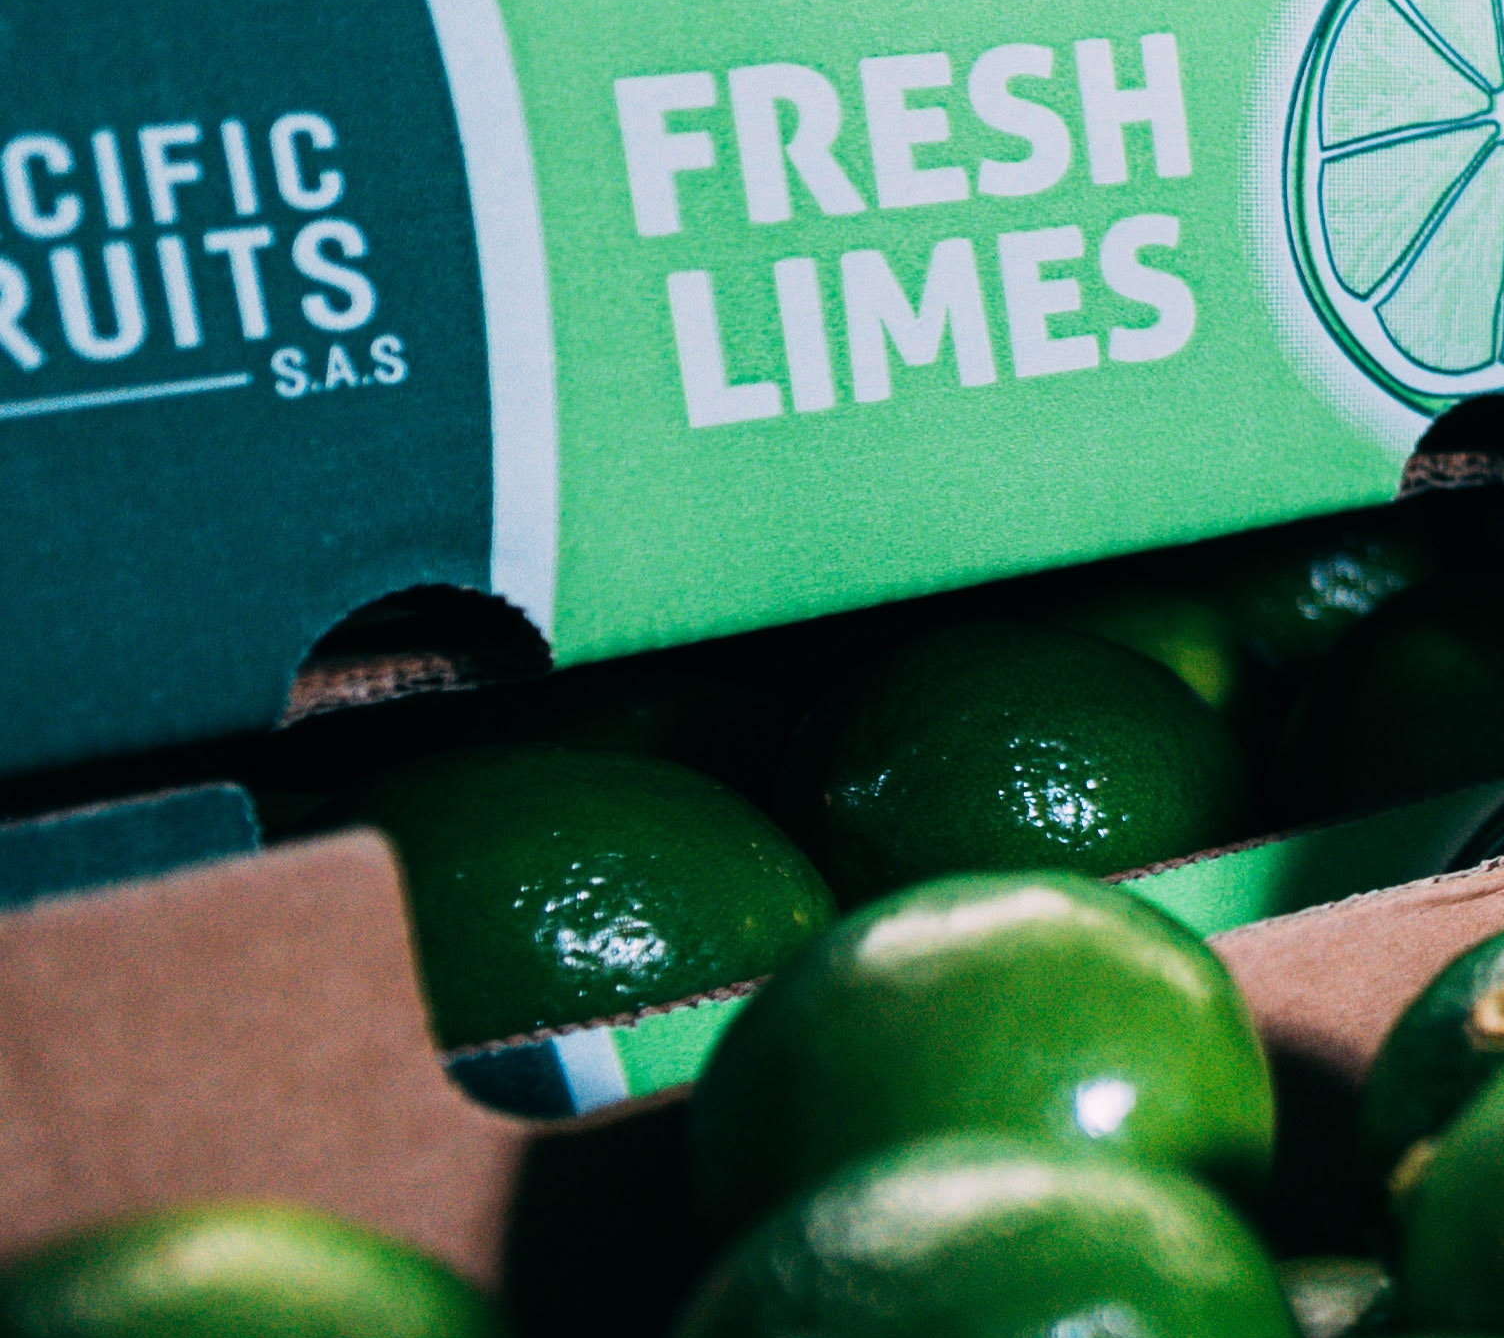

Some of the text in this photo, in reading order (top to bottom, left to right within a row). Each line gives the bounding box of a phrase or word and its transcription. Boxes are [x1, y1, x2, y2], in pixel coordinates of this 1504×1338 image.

[0, 110, 345, 240] CIFIC
[613, 32, 1193, 237] FRESH
[270, 334, 409, 399] S.A.S
[667, 213, 1197, 429] LIMES
